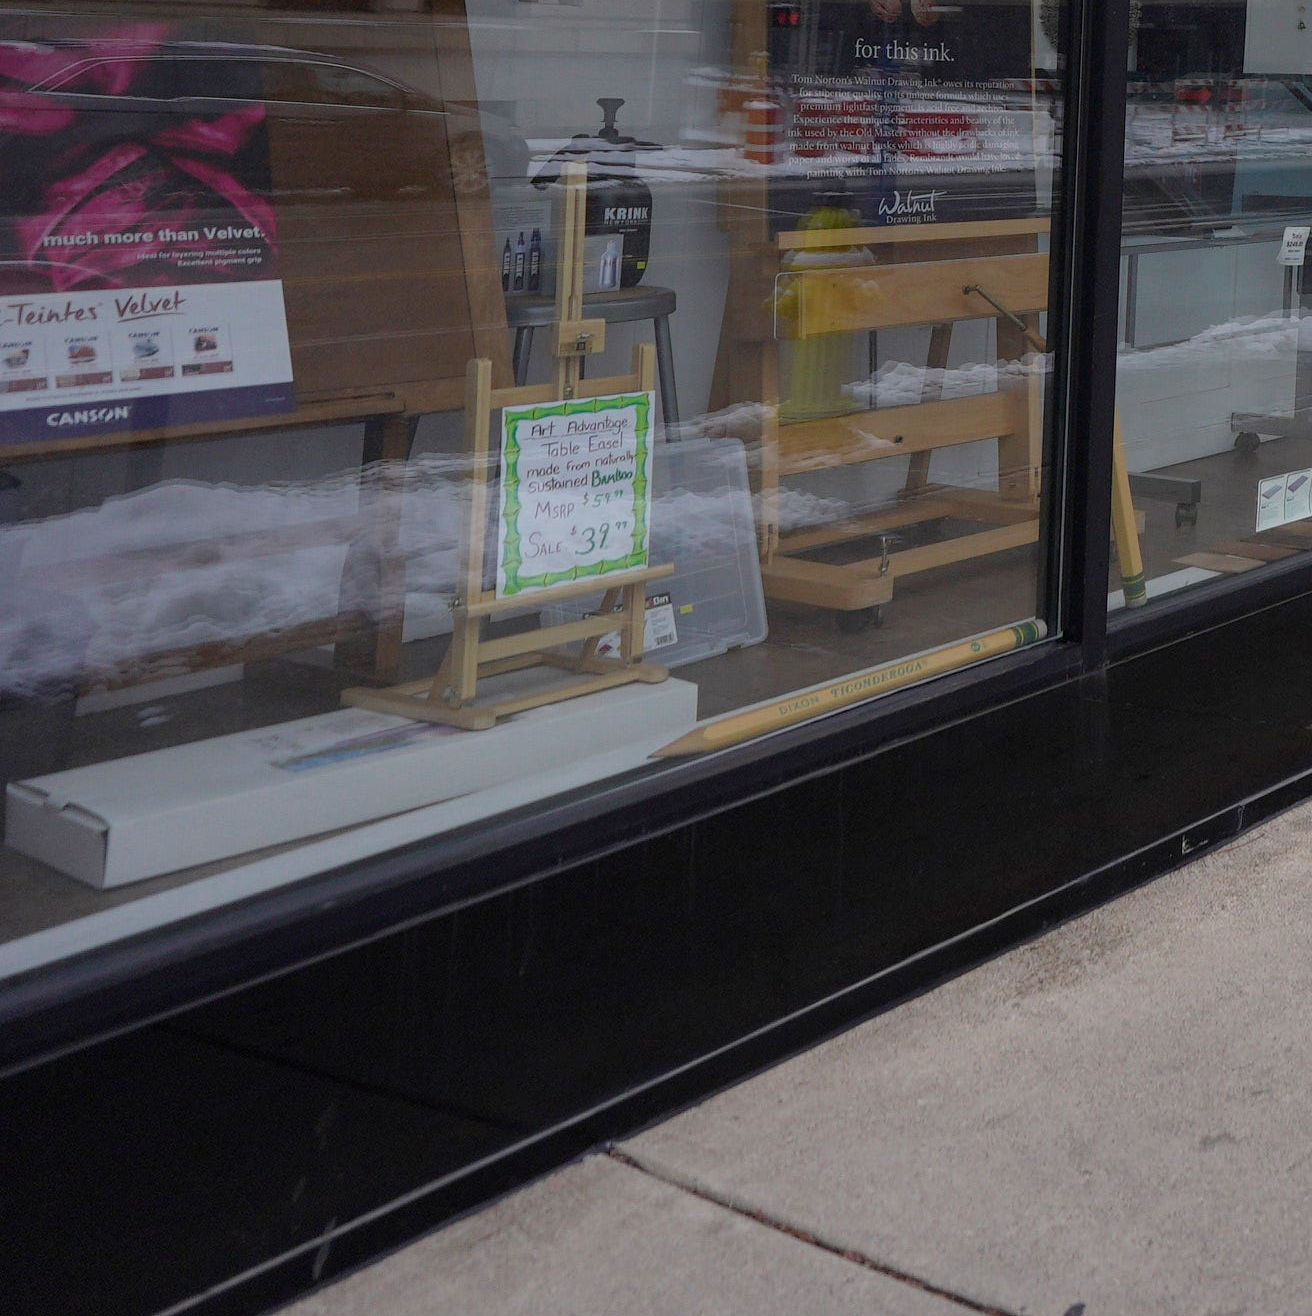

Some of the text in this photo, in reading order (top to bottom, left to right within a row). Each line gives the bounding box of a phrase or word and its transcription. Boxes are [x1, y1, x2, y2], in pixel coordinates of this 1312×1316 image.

[855, 38, 955, 61] for this ink.
[792, 74, 814, 84] Tom
[815, 75, 852, 85] Norton's
[855, 76, 885, 86] Walnut
[888, 77, 923, 88] Drawing
[964, 80, 974, 88] its
[976, 81, 1014, 90] reputation
[800, 88, 991, 101] for superior quality to its unique formula which
[801, 101, 879, 112] premium lightfast
[793, 115, 1014, 126] Experience the unique characteristics and beauty of the
[788, 127, 956, 140] ink used by the Old Masters without the
[789, 141, 922, 150] made from walnut husks which
[788, 152, 979, 166] paper and all Rembrandt would
[806, 165, 954, 179] painting with Tom Walnut
[879, 190, 947, 215] Walnut
[604, 207, 649, 220] KRINK
[886, 214, 922, 224] Drawing
[44, 225, 266, 247] much more than Velvet.
[205, 249, 236, 257] multiple
[178, 259, 212, 267] Excellent
[214, 258, 245, 266] pigment
[115, 291, 187, 319] Velvet
[47, 406, 130, 427] CANSON
[531, 415, 629, 437] Art Advantage
[541, 432, 623, 457] Table Easel
[527, 462, 560, 479] made
[595, 451, 634, 467] naturally
